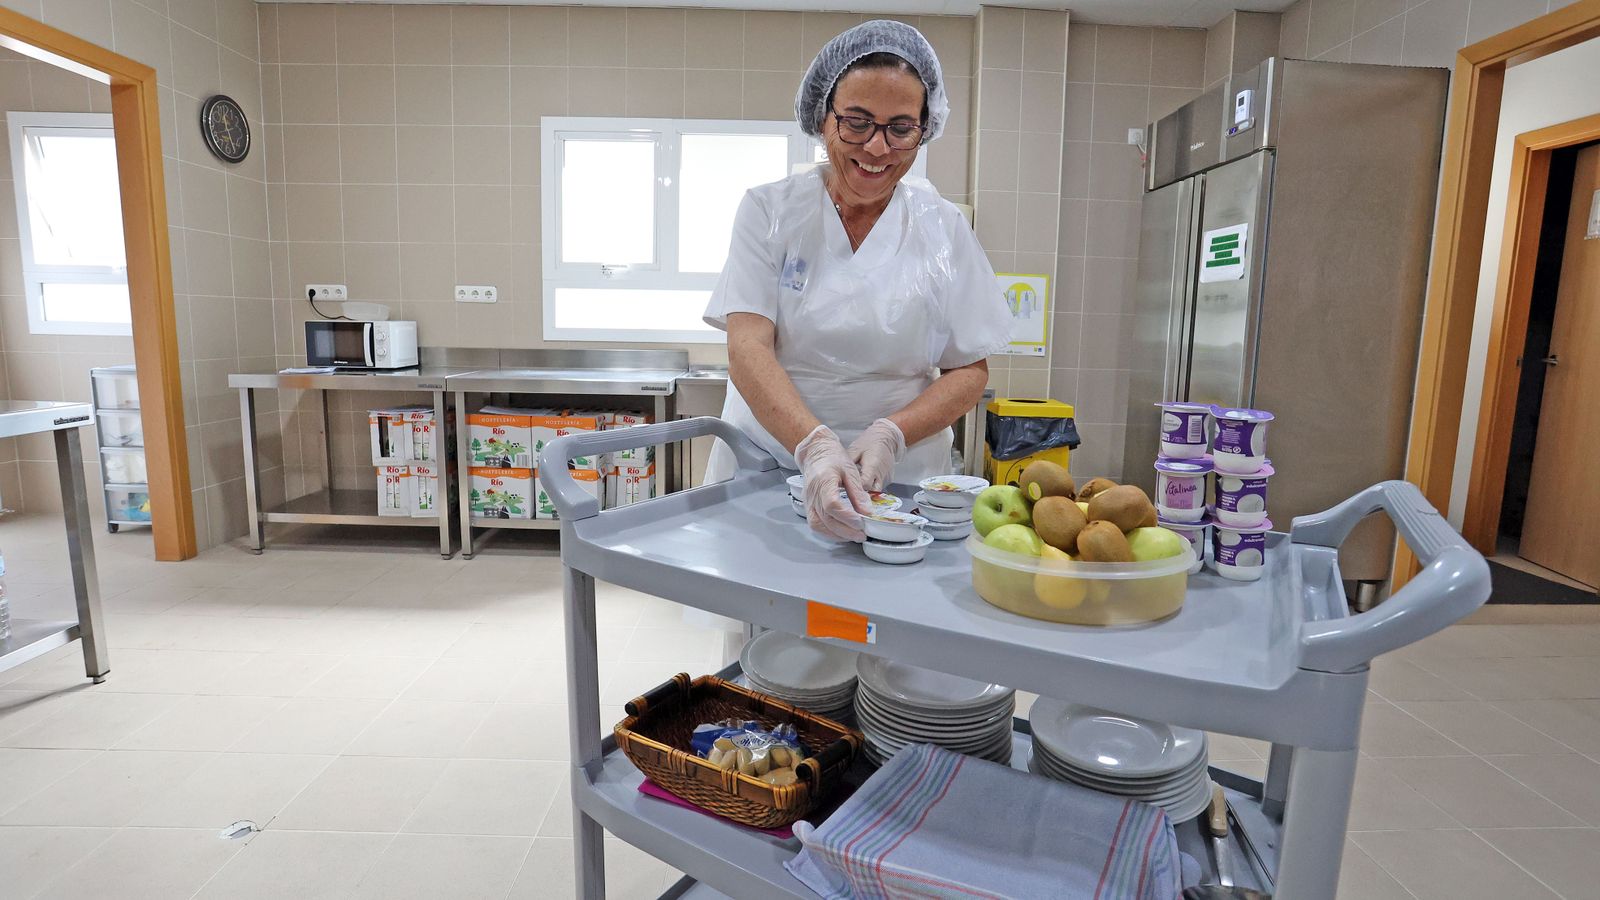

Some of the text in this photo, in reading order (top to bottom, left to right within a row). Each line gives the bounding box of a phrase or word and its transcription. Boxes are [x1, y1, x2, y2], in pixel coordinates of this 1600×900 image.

[622, 416, 636, 424] Río
[492, 427, 506, 435] Río
[627, 467, 640, 475] Río
[1165, 481, 1197, 496] Vitalinea
